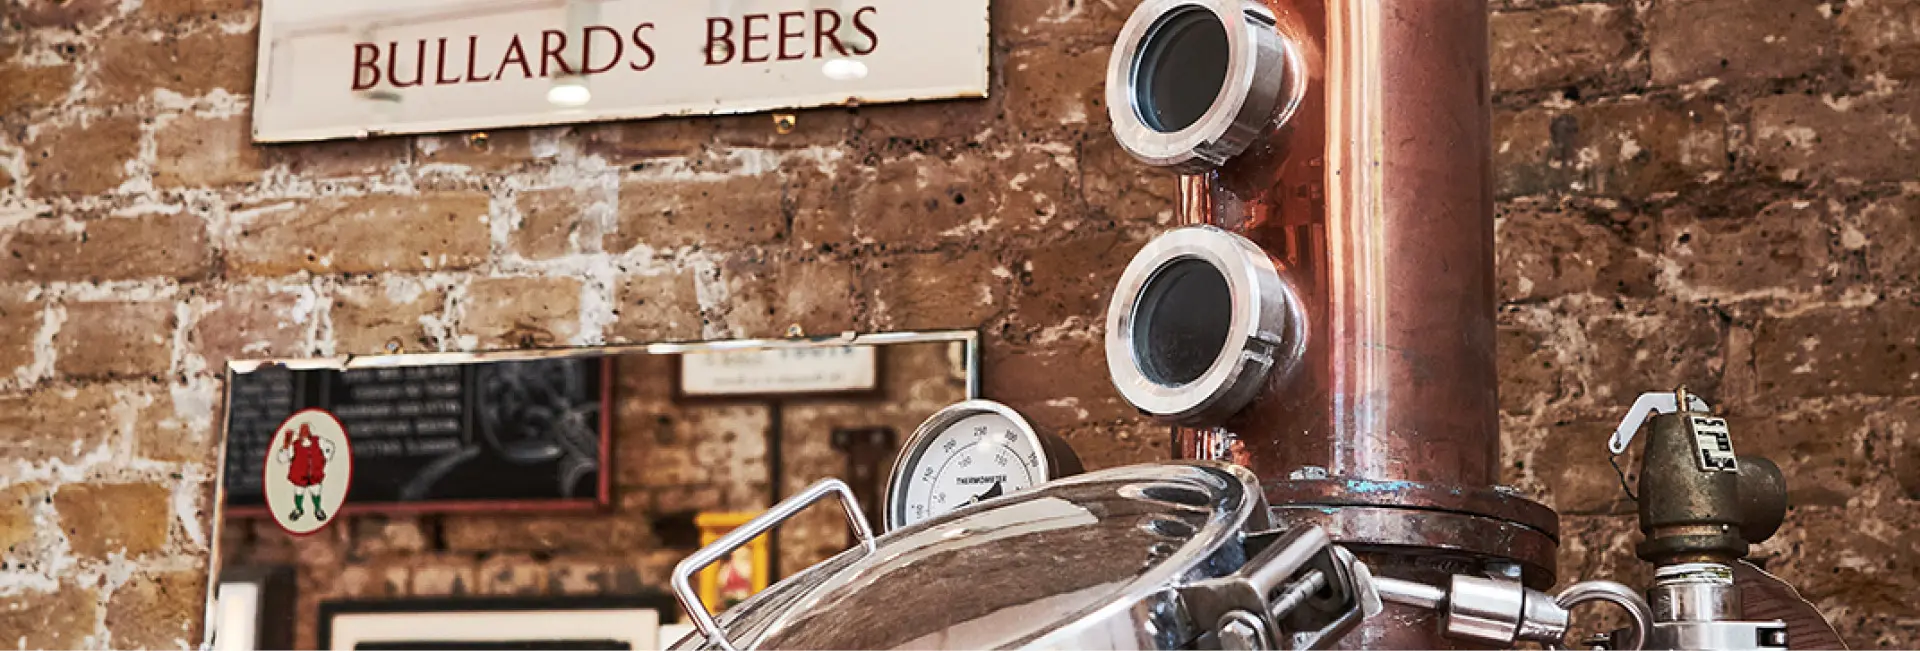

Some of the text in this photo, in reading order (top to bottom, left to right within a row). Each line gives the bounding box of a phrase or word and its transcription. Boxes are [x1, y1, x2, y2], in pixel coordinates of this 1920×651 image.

[351, 6, 878, 92] BULLARDS BEERS
[956, 475, 1007, 485] THERMOMETER
